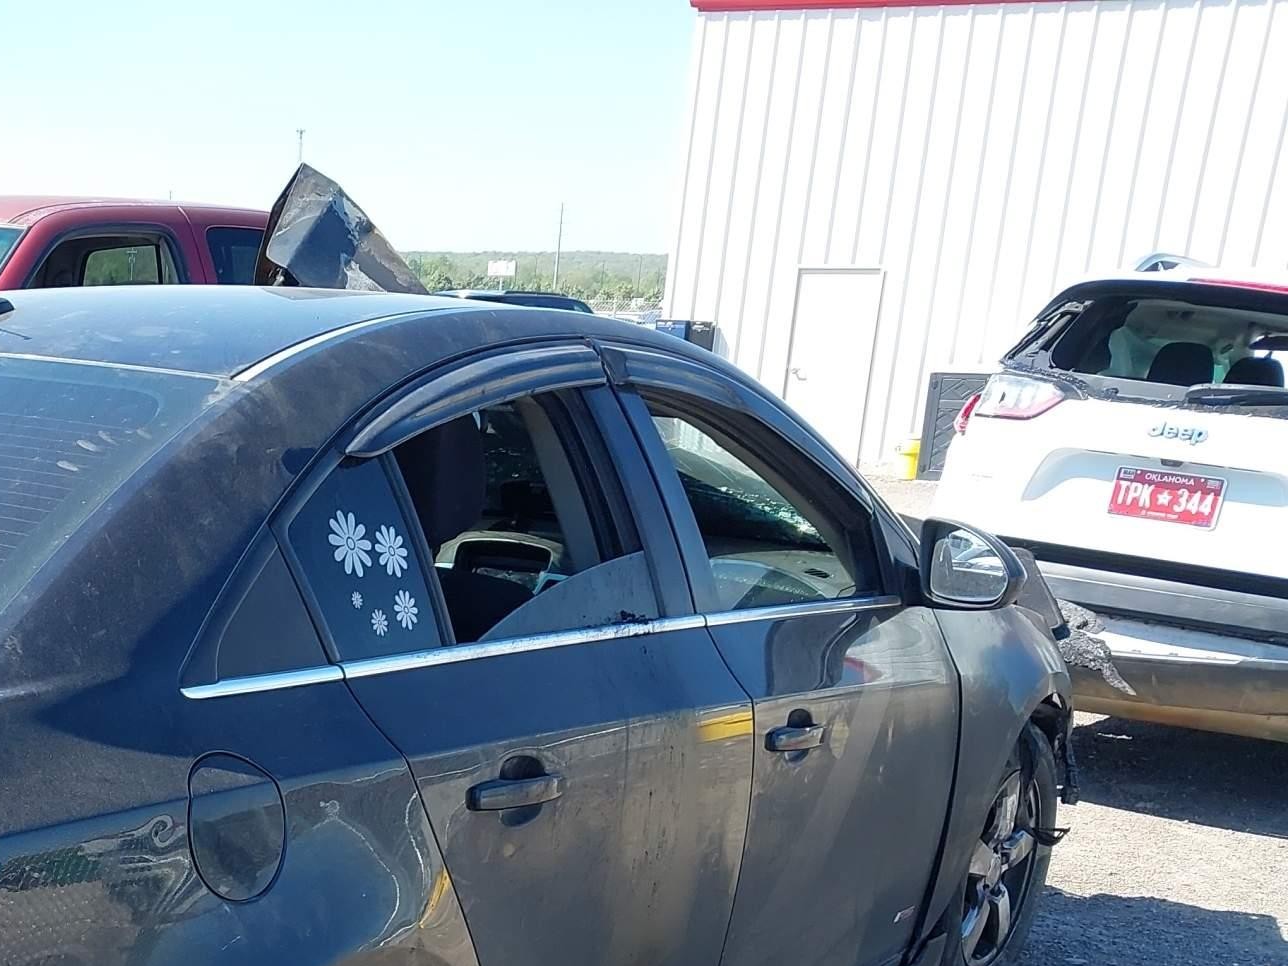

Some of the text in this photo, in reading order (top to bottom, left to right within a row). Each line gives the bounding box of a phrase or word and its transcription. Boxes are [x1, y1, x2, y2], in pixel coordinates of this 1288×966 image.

[1147, 421, 1209, 446] Jeep
[1145, 472, 1195, 486] OKLAHOMA
[1116, 480, 1215, 516] TPK 344
